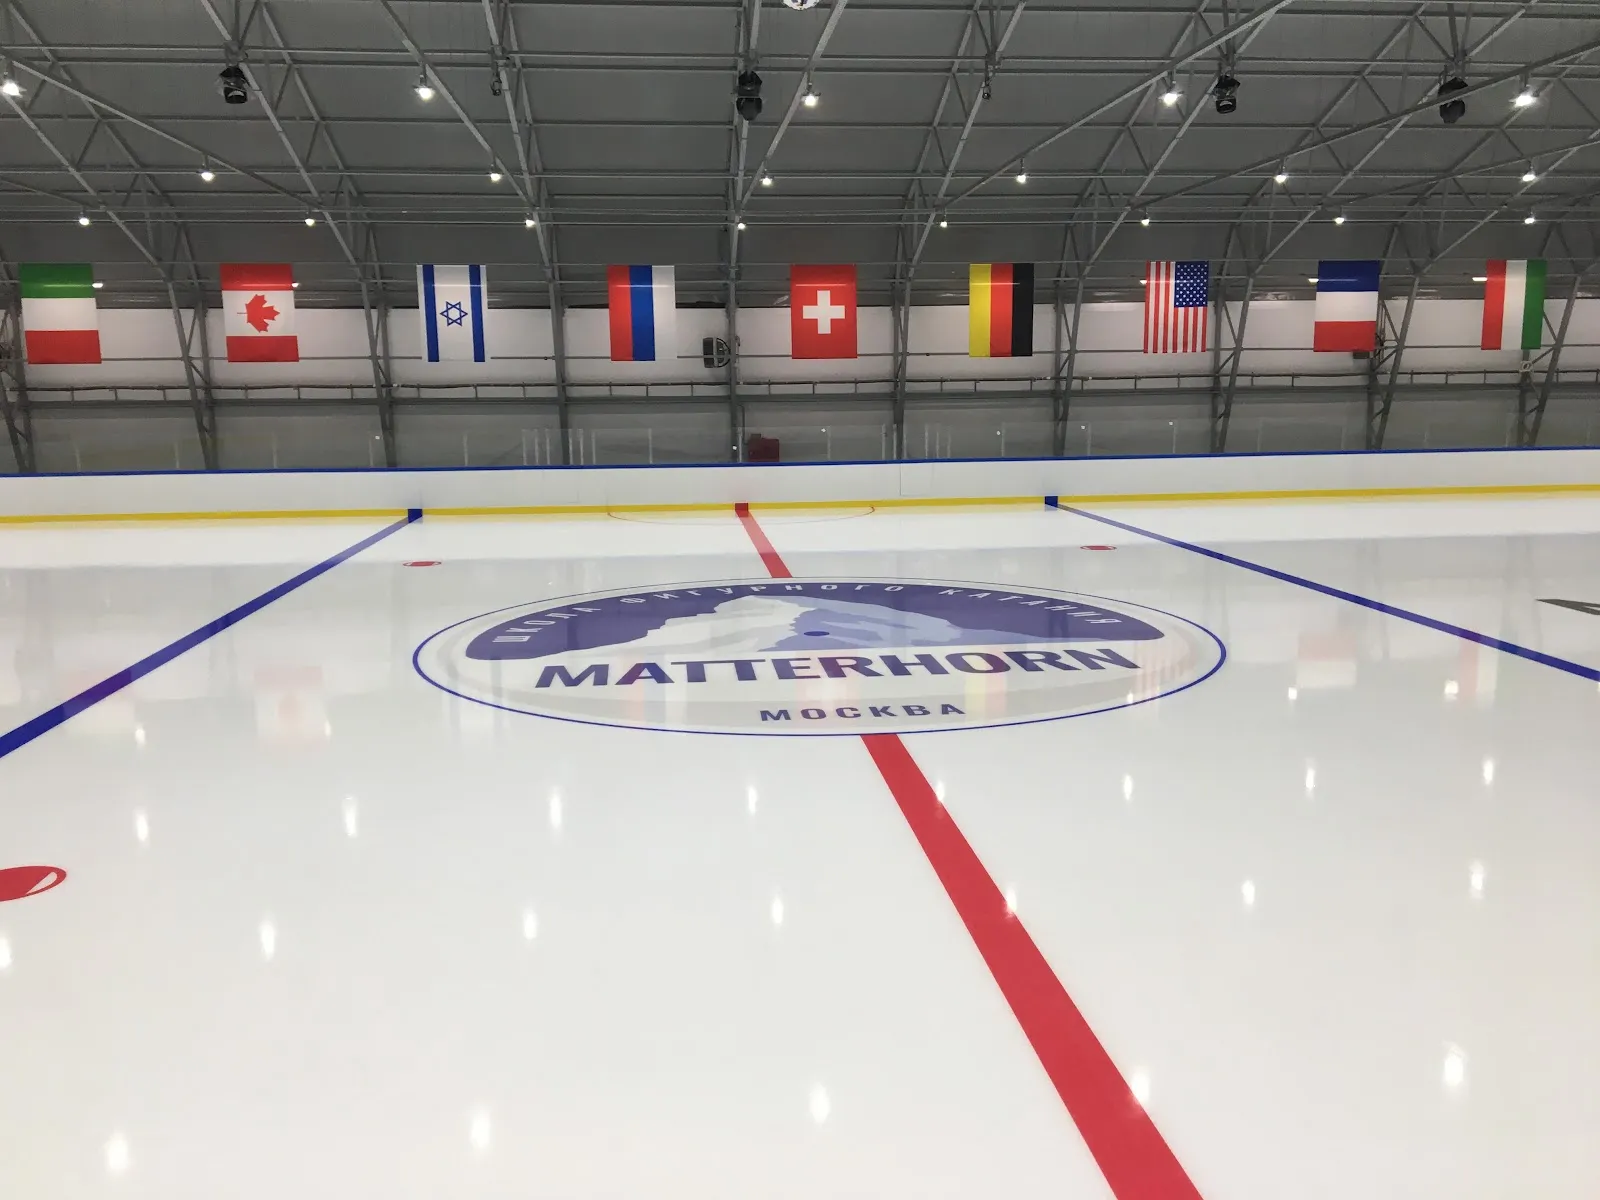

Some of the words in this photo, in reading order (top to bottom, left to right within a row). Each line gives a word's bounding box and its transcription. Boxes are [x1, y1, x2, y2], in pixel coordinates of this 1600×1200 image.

[492, 606, 601, 643] ШКОЛА
[619, 584, 905, 604] ФИГУРНОГО
[938, 588, 1123, 624] КАТАНИЯ
[535, 648, 1141, 689] MATTERHORN
[760, 703, 965, 721] МОСКВА
